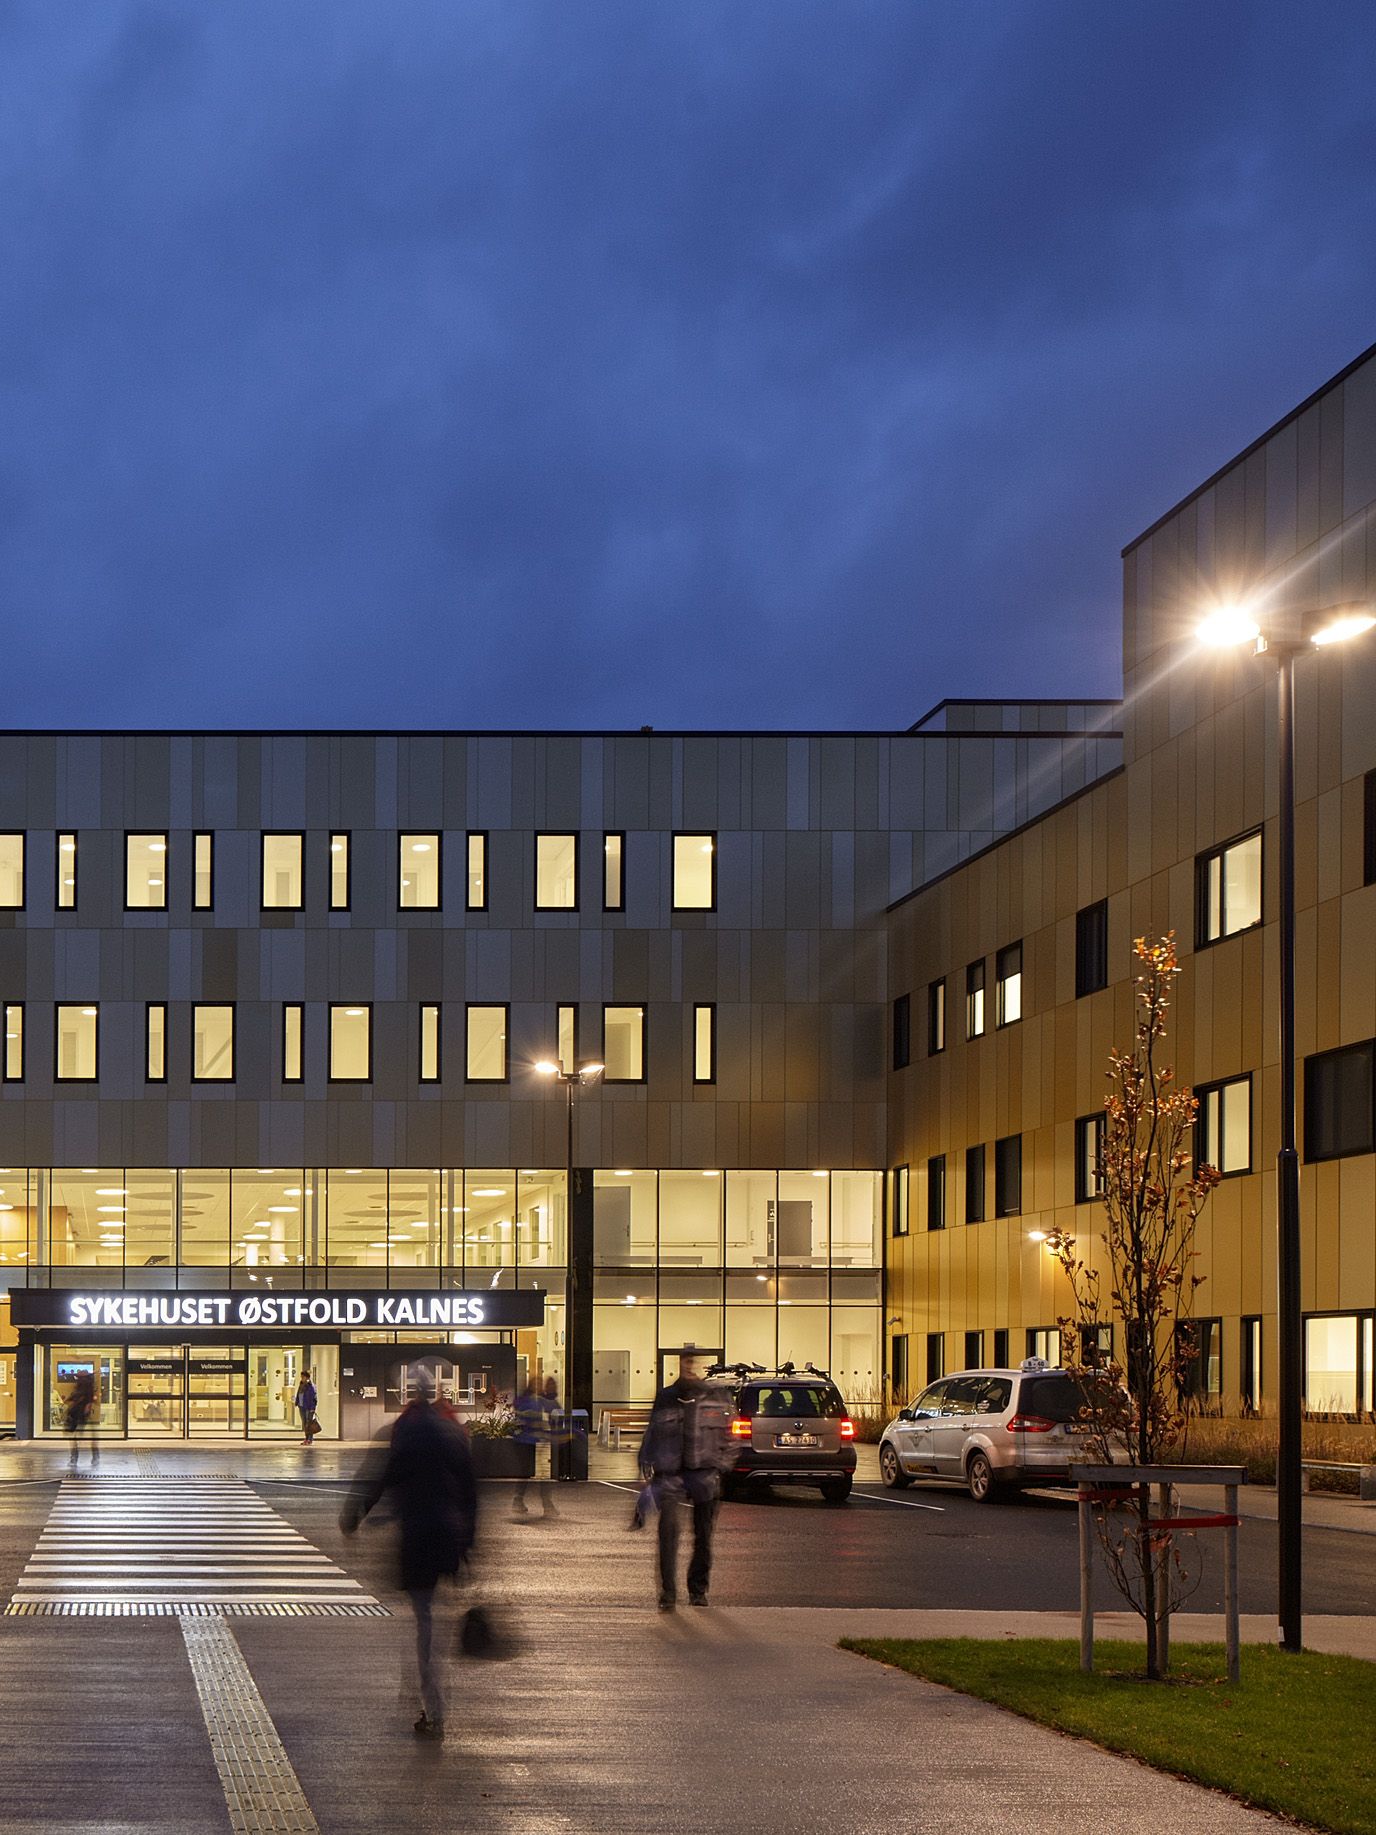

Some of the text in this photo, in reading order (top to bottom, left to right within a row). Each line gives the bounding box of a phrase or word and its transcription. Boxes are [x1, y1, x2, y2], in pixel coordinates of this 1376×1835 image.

[70, 1296, 485, 1325] SYKEHUSET ØSTFOLD KALNES
